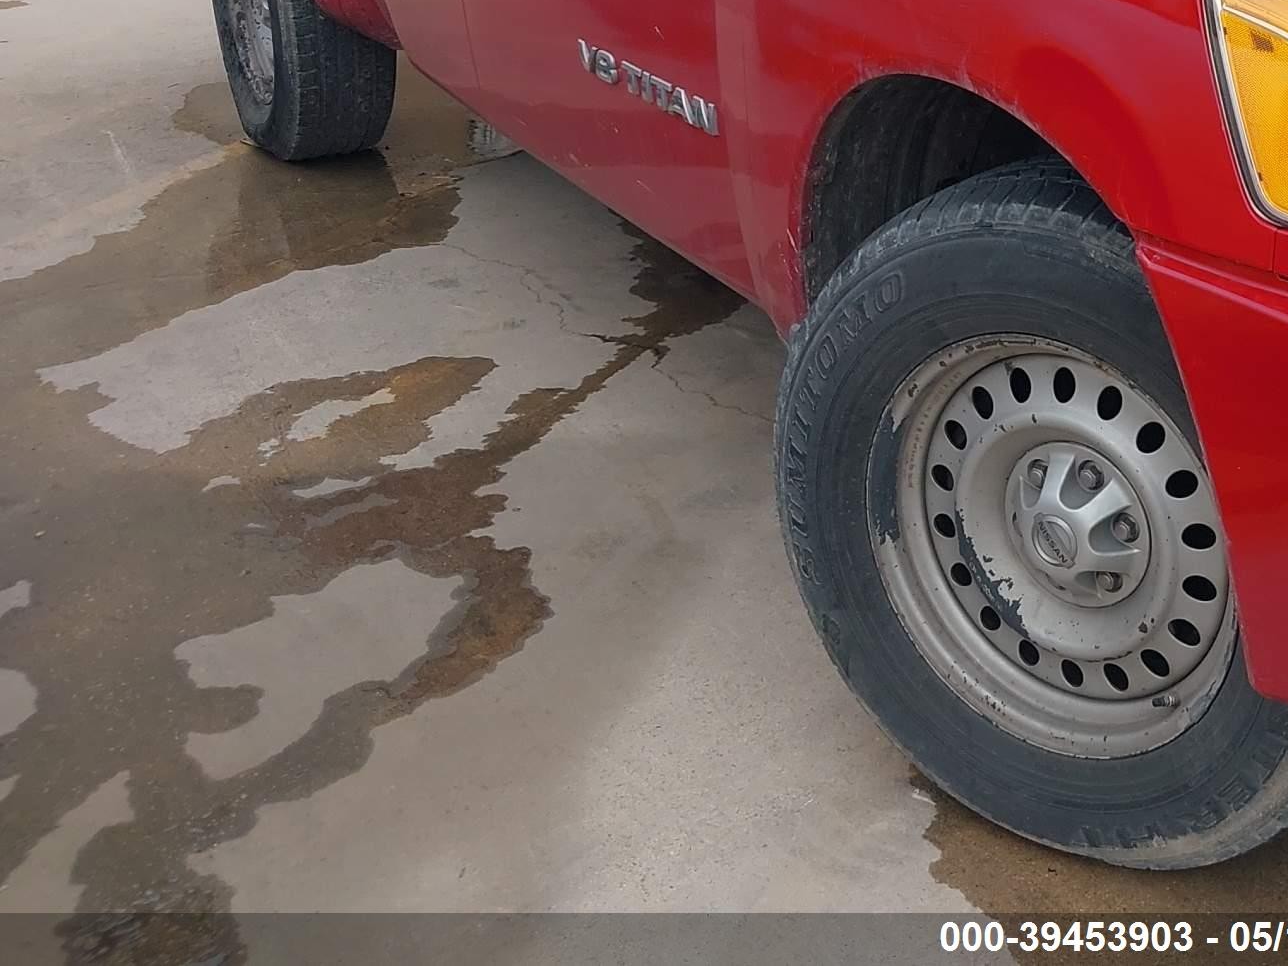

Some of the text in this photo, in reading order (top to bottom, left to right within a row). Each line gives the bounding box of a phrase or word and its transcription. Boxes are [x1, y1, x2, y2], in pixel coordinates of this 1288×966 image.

[577, 37, 720, 137] V8 TITAN
[785, 269, 906, 586] SUMITOMO
[1037, 520, 1069, 564] NISSAN
